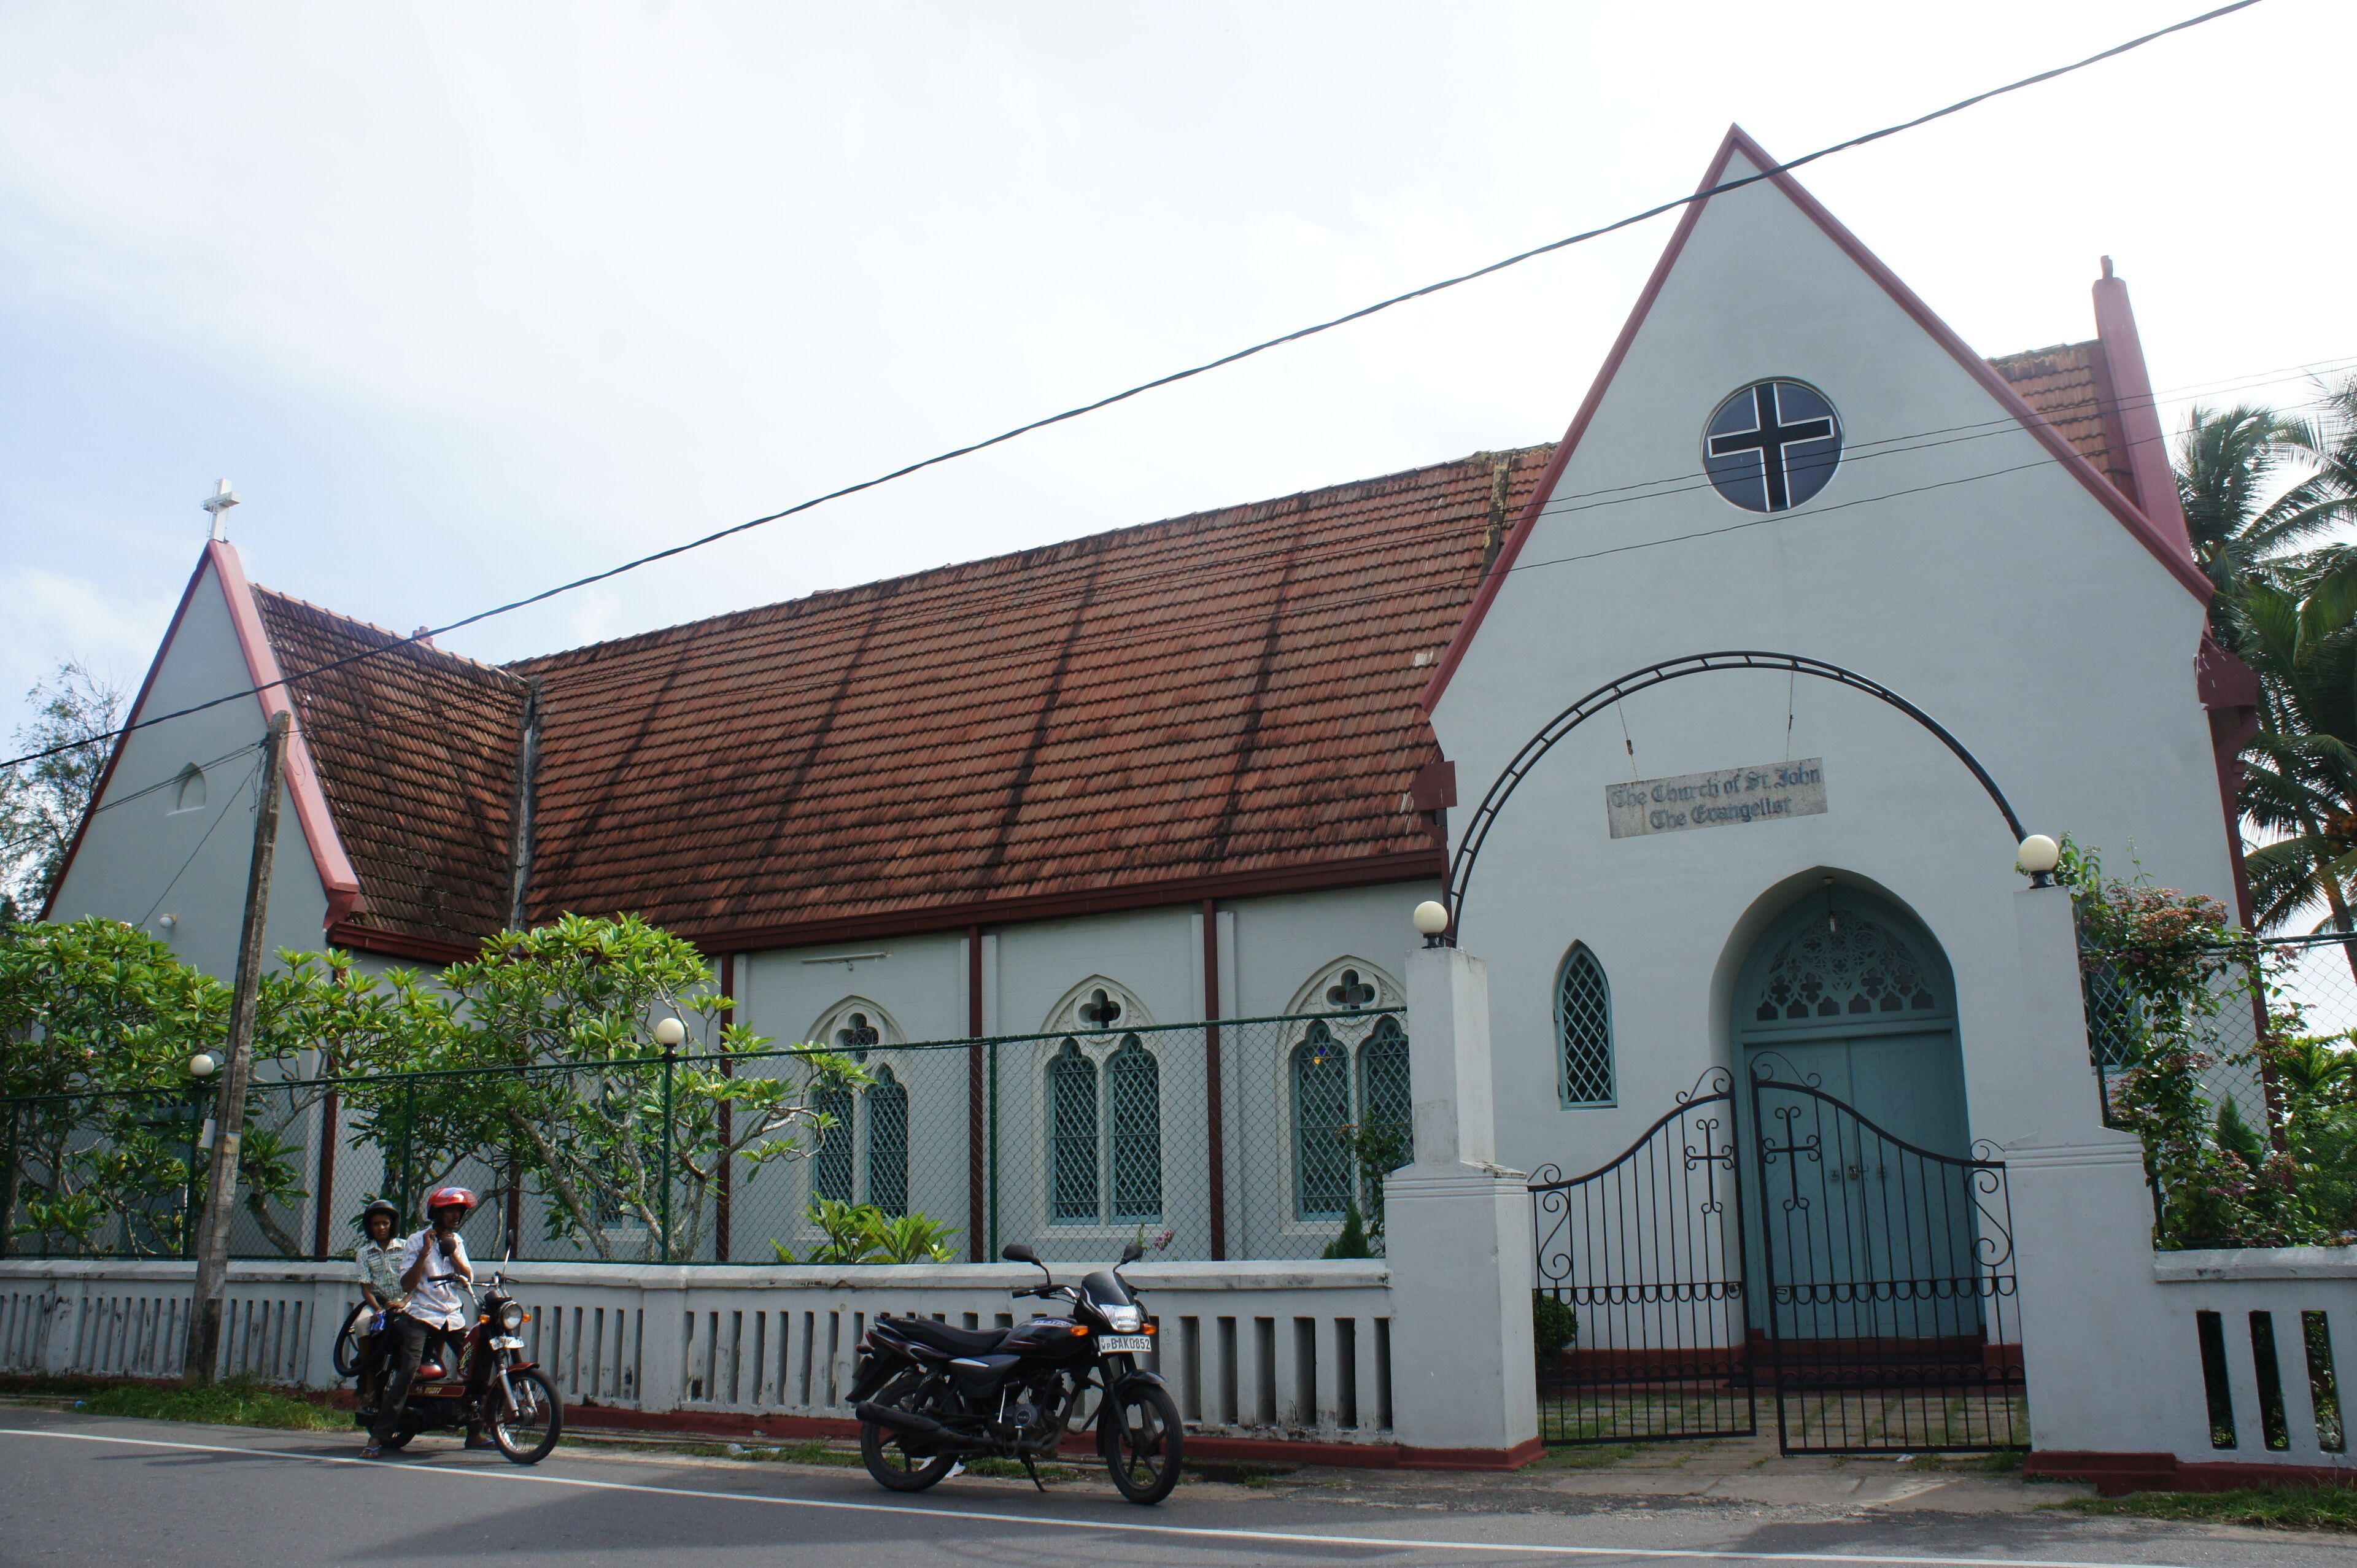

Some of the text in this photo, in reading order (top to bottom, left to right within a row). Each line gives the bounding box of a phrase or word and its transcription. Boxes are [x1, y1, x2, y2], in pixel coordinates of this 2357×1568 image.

[1611, 762, 1821, 808] The Church of St. John
[1649, 796, 1793, 829] The Evangelist
